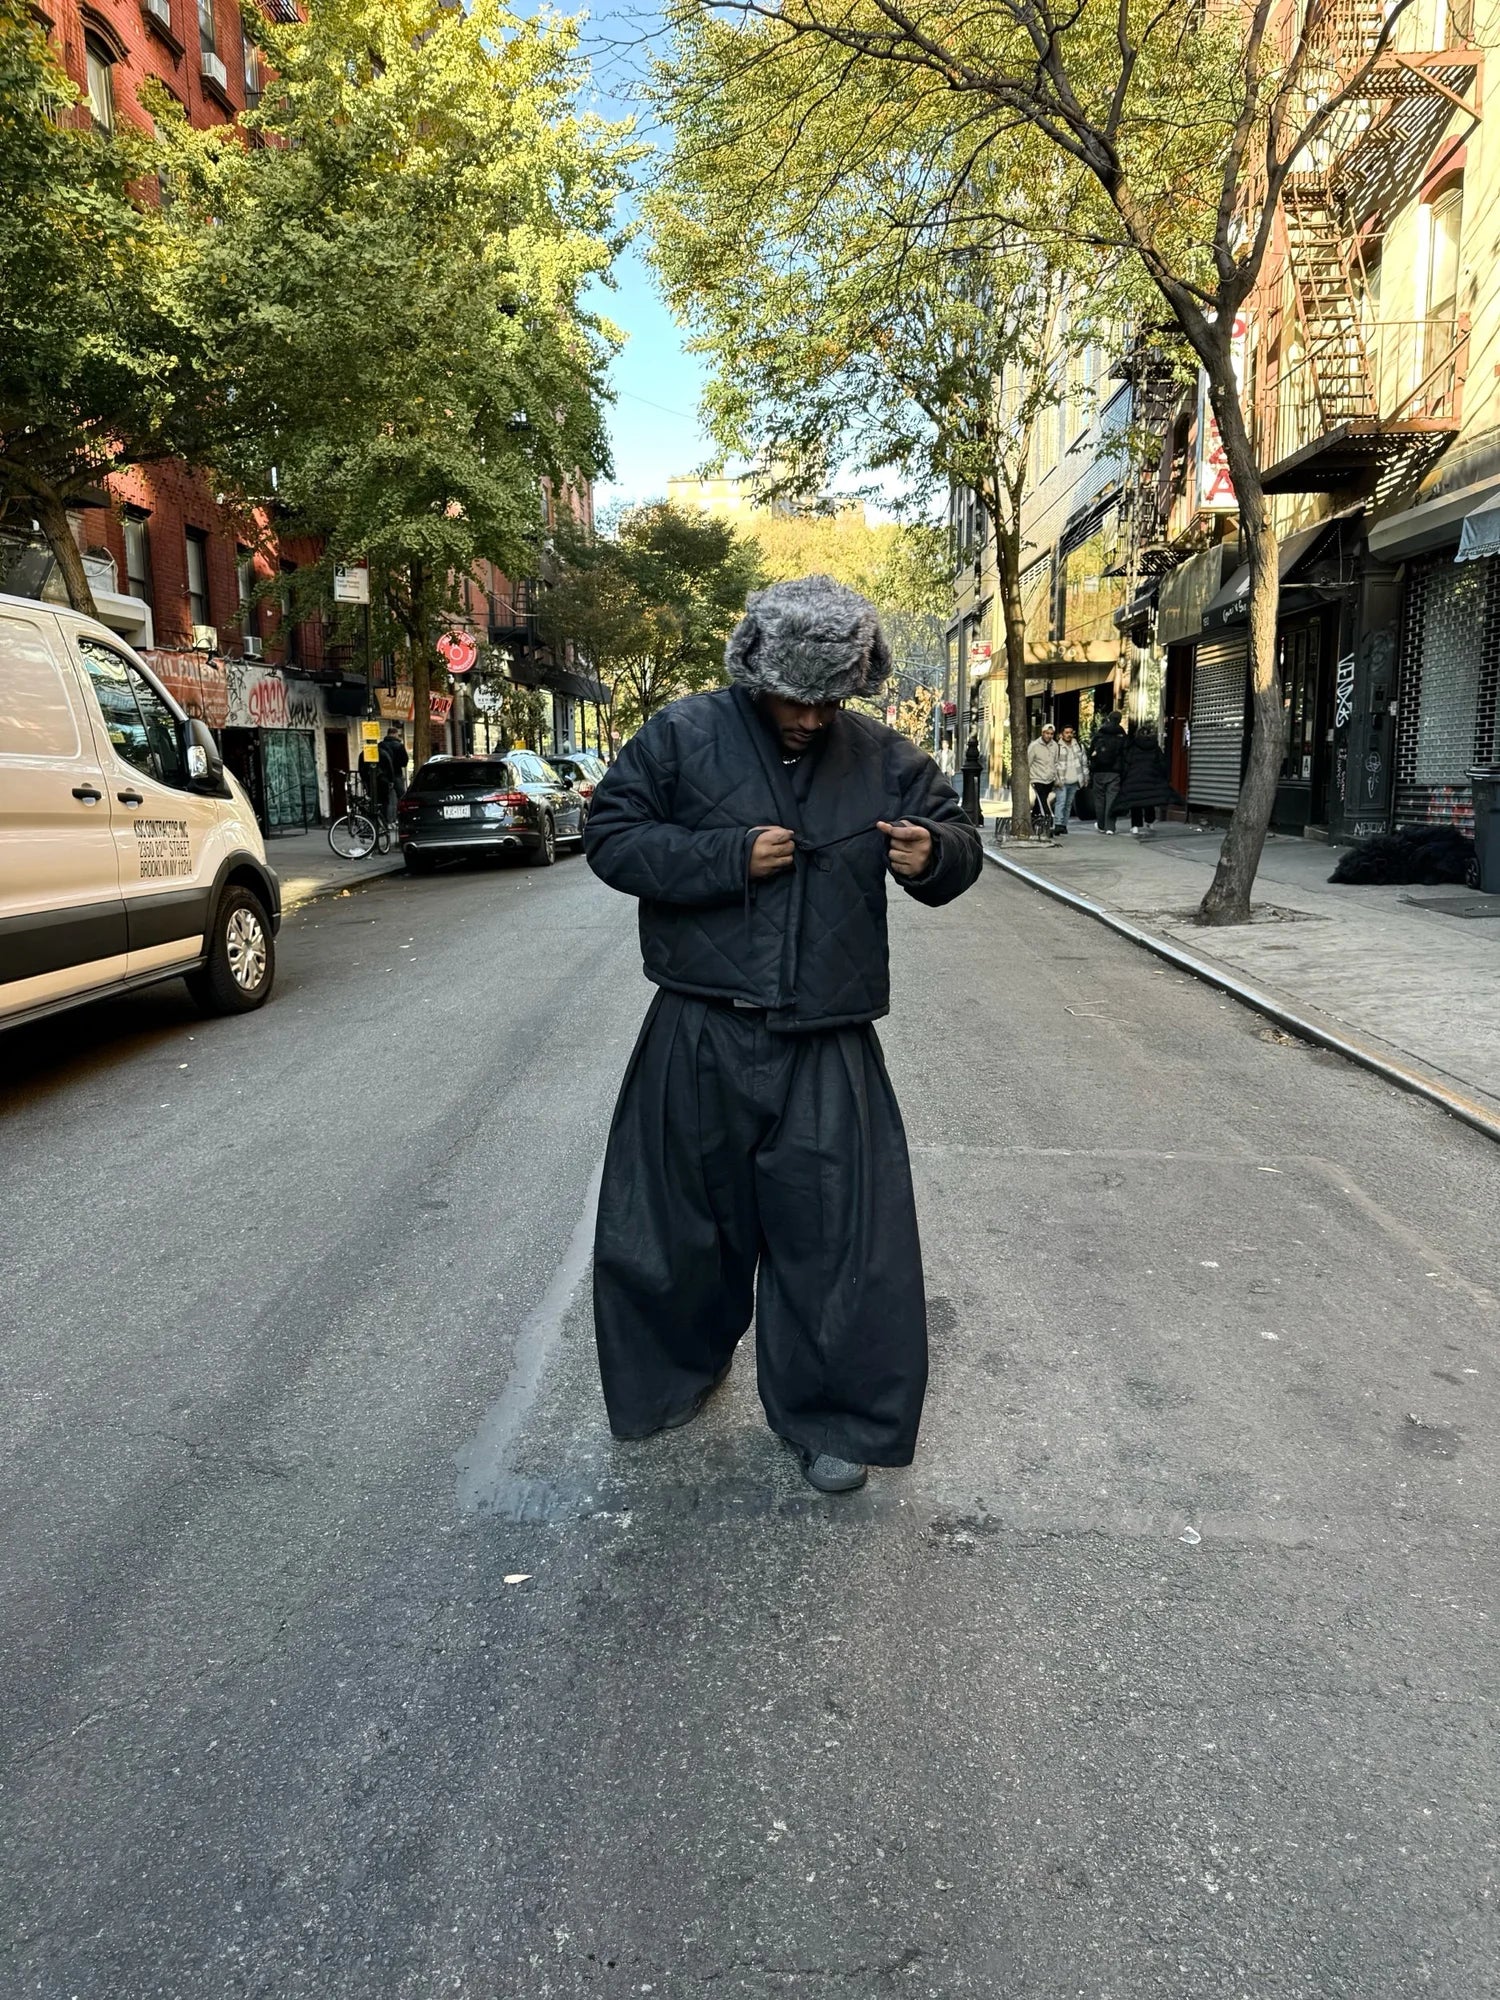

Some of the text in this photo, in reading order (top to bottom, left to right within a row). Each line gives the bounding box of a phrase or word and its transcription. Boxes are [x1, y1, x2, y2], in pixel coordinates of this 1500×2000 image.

[1050, 644, 1077, 658] 196
[169, 841, 191, 857] STREET
[140, 859, 193, 878] BROOKLYN NY 11214
